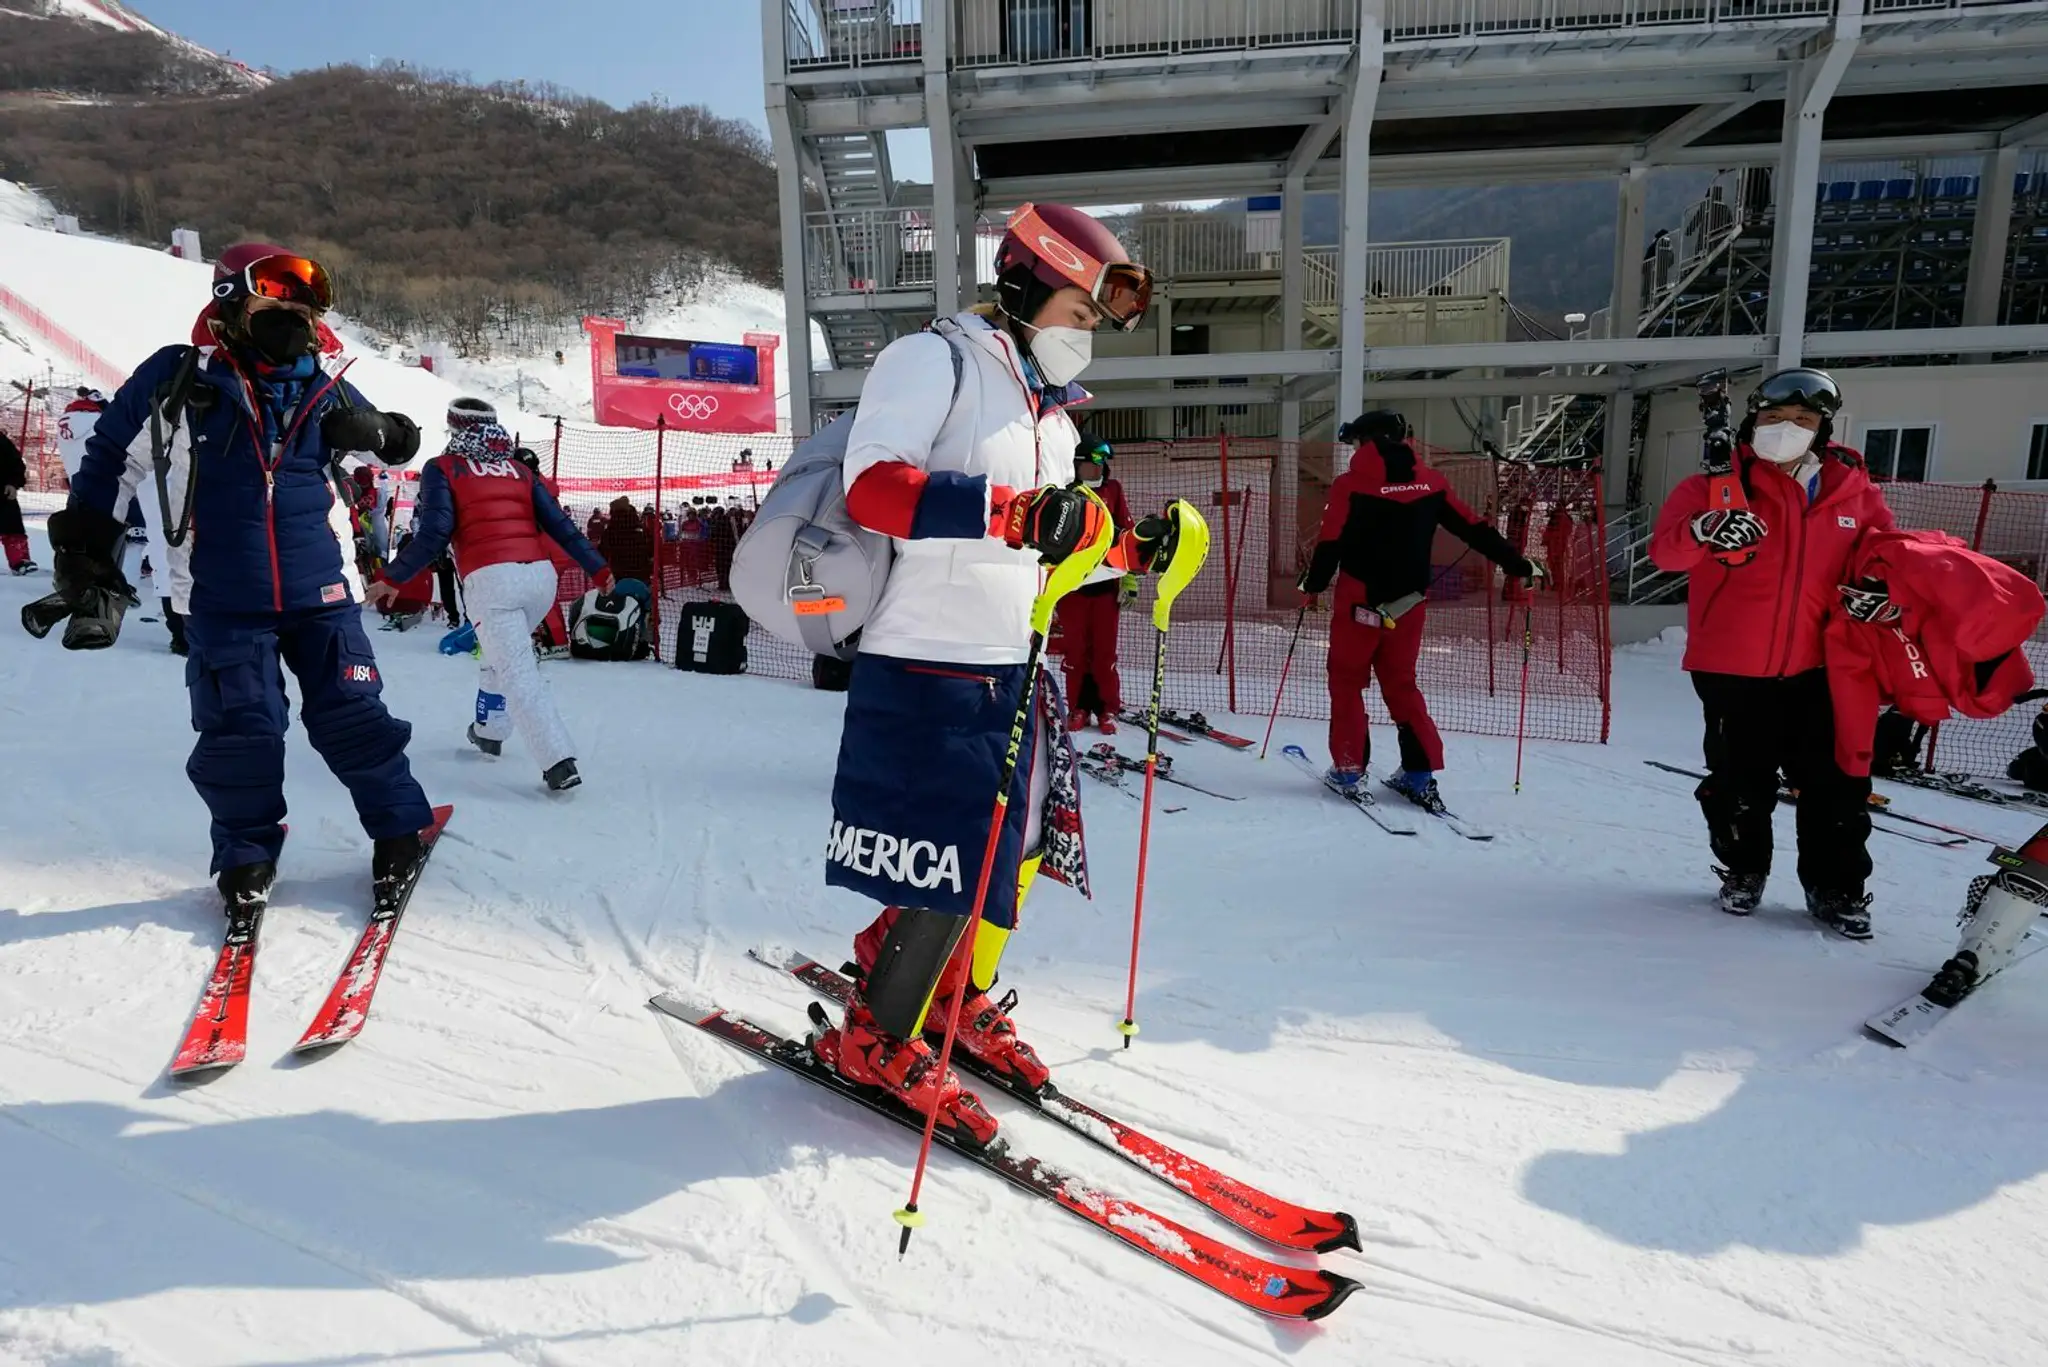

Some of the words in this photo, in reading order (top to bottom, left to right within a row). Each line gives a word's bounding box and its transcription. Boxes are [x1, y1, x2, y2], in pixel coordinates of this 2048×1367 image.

[467, 458, 519, 479] USA
[1380, 483, 1431, 494] CROATIA
[1011, 496, 1026, 533] LEKI
[1053, 501, 1070, 540] reusch
[1891, 627, 1928, 679] KOR
[353, 665, 370, 682] USA
[1005, 709, 1026, 767] LEKI
